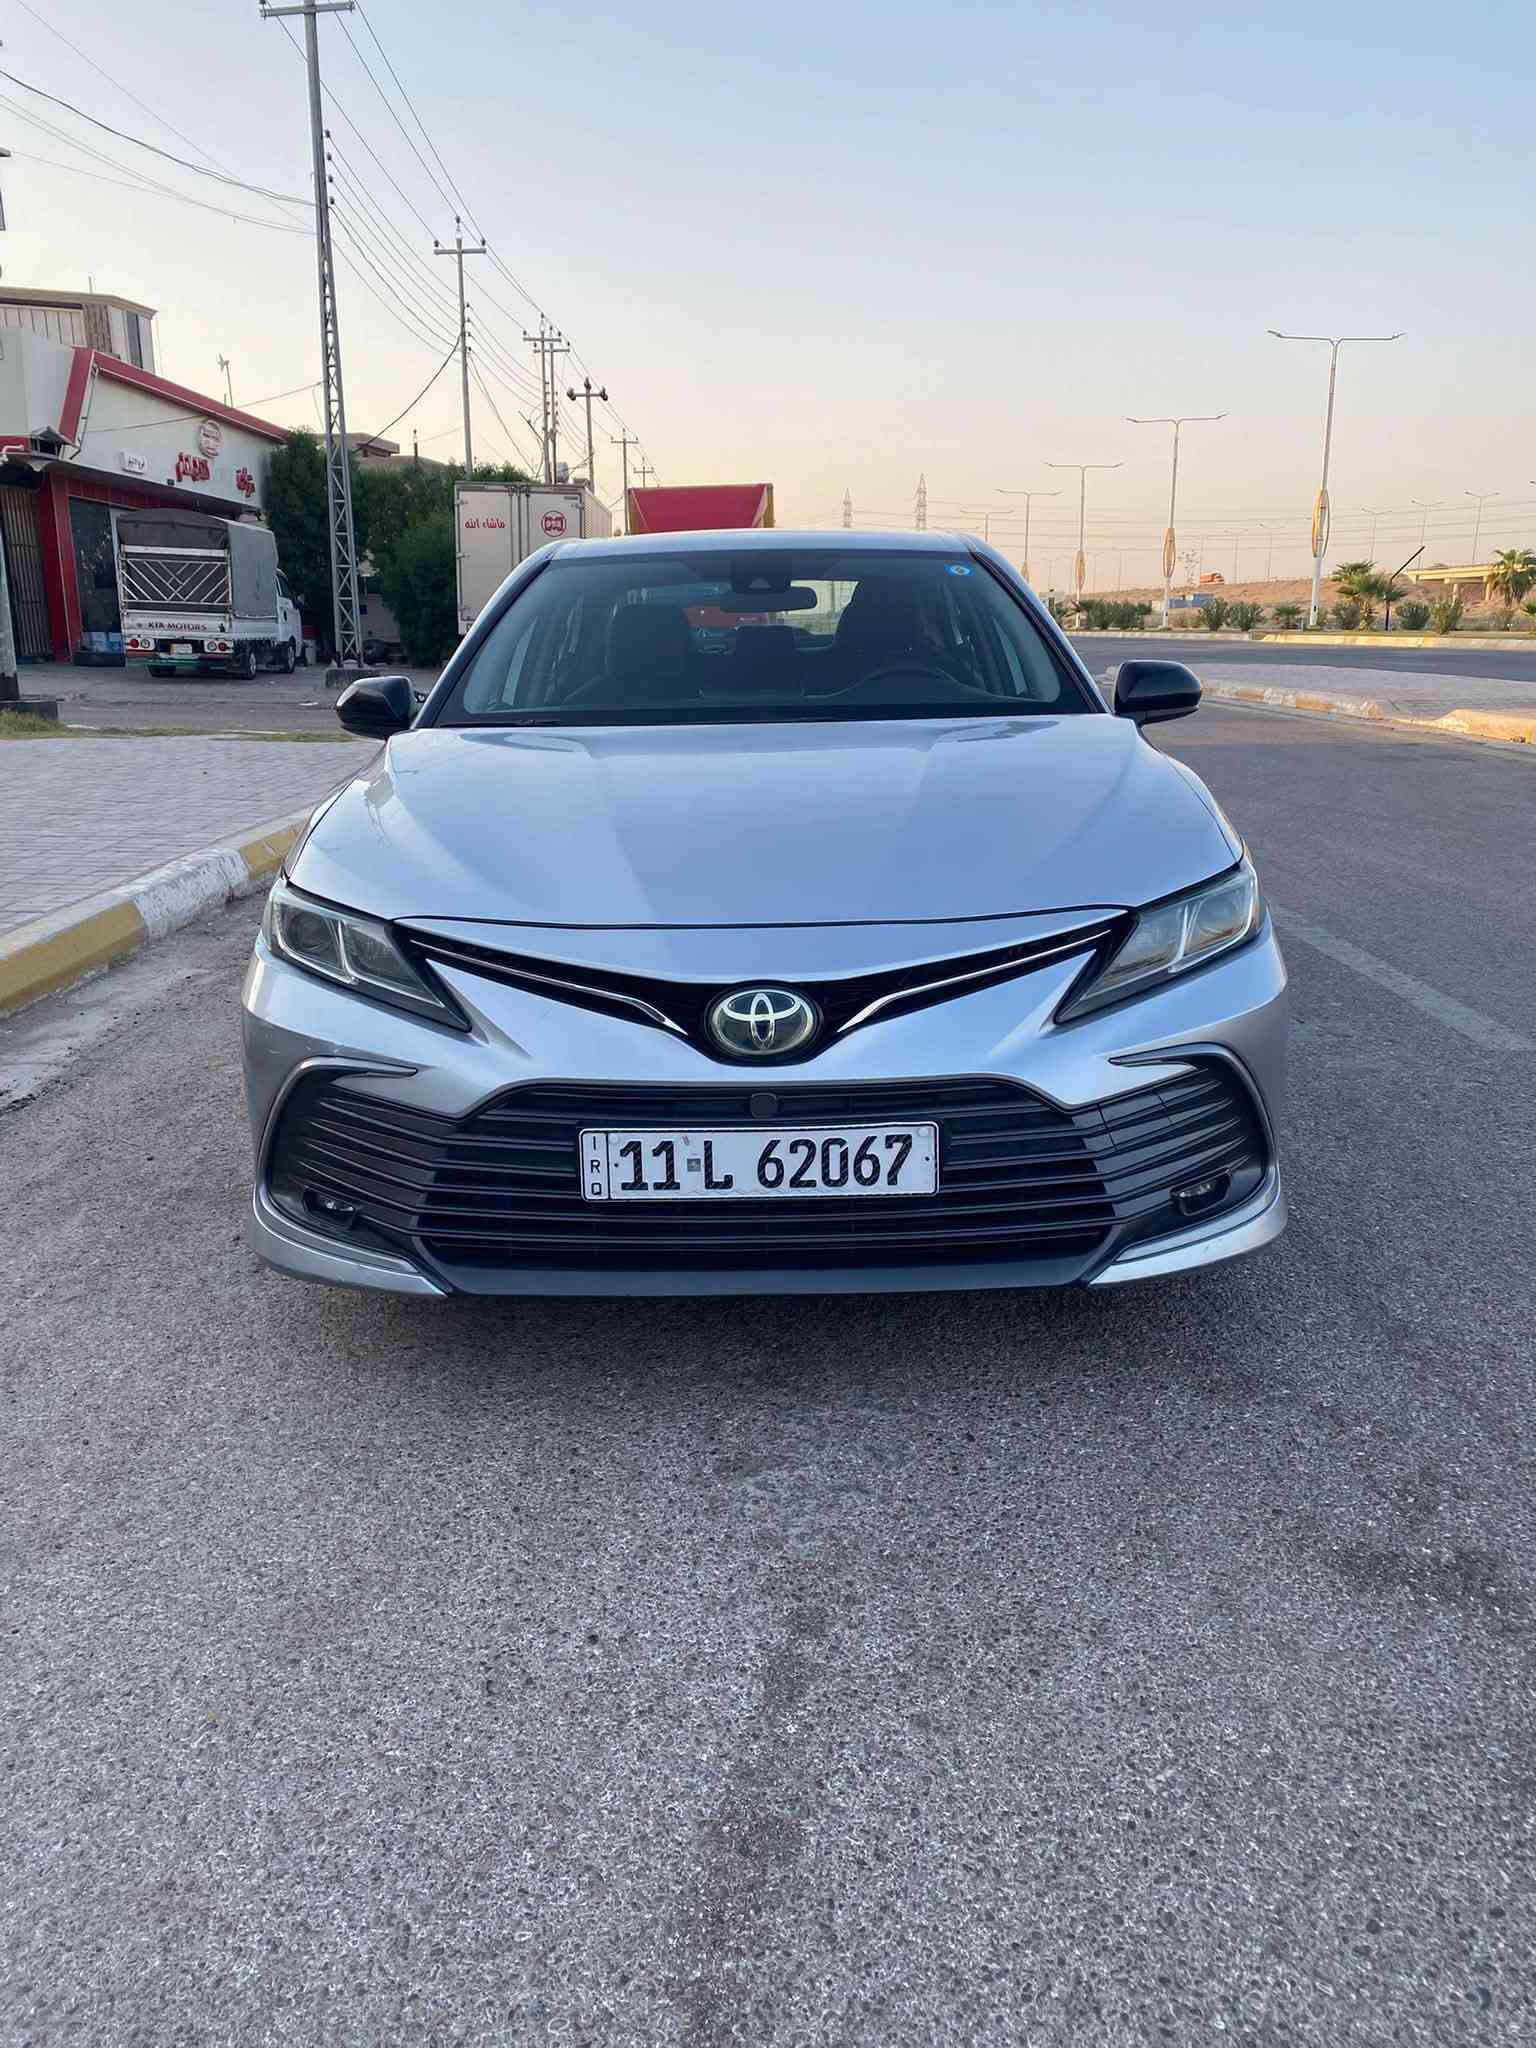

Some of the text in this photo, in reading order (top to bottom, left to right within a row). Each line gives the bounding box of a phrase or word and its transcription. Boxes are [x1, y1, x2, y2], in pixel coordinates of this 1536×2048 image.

[483, 517, 505, 529] ماشاء
[148, 621, 207, 632] KIA MOTORS
[620, 1134, 912, 1190] 11 L 62067
